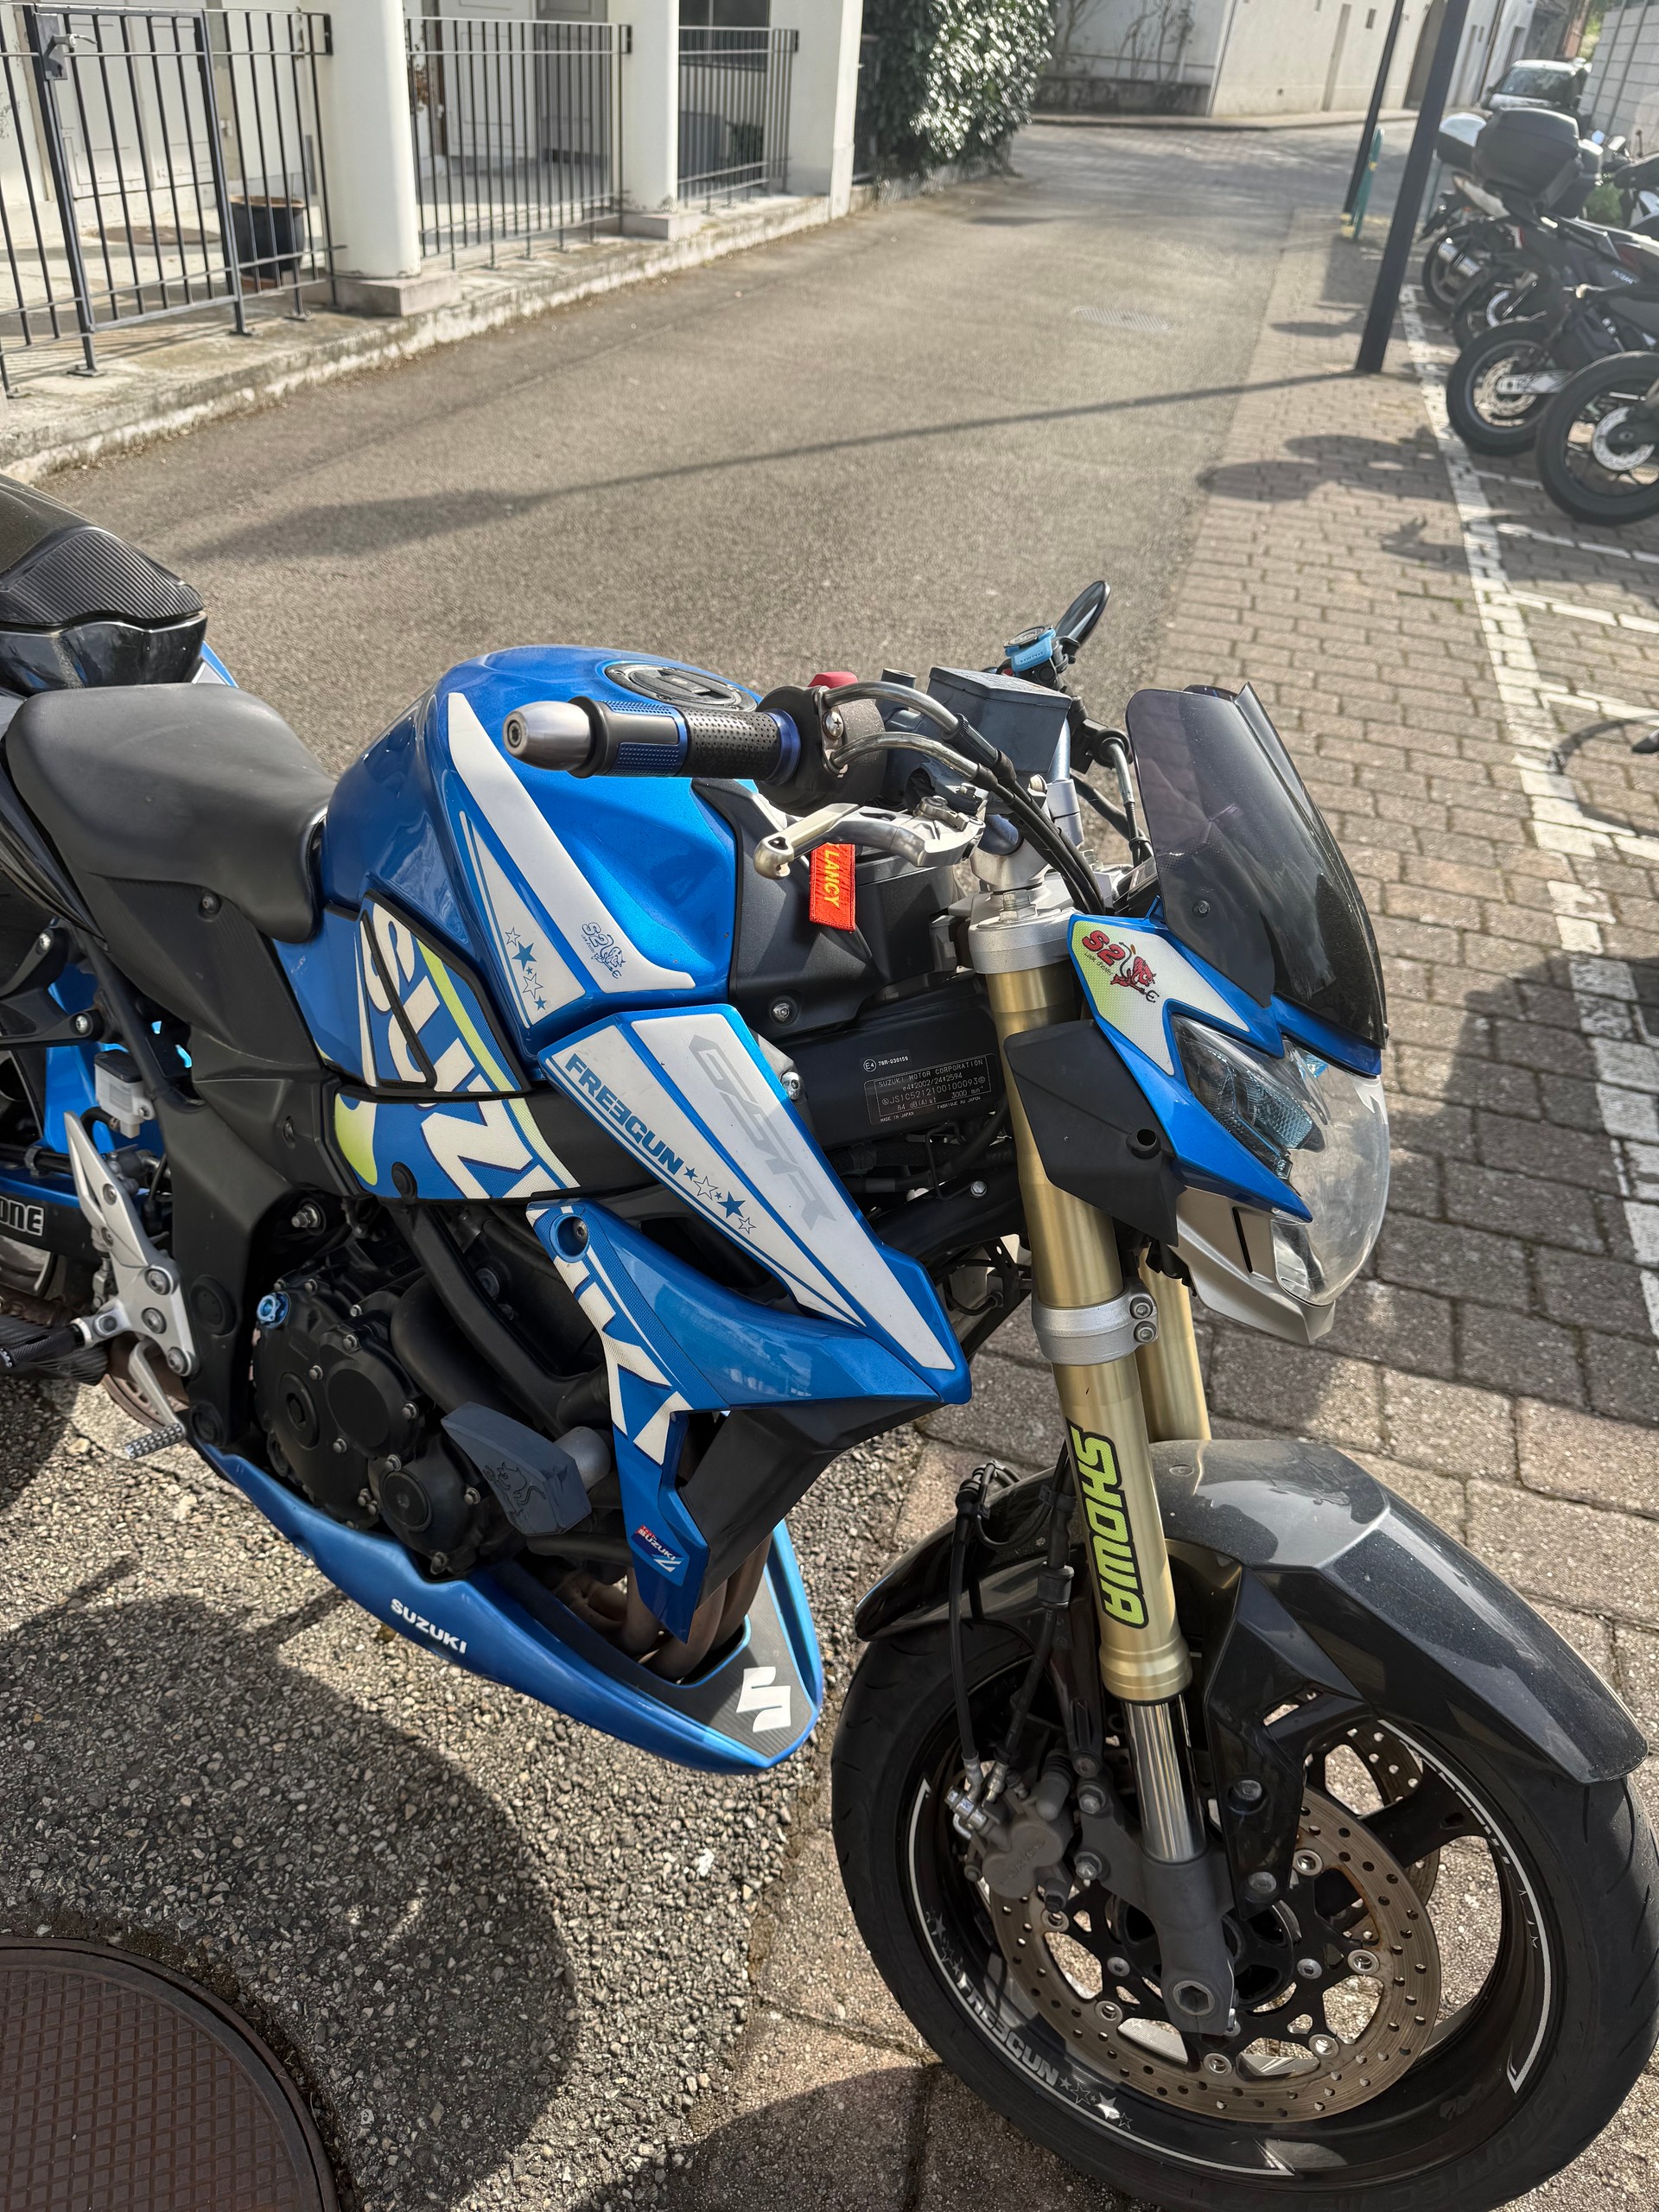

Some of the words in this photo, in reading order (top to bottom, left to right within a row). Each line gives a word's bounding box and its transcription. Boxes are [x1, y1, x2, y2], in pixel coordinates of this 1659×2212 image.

[823, 849, 840, 908] LANCY
[1082, 930, 1126, 967] S2
[879, 1077, 904, 1088] SUZUKI
[909, 1071, 931, 1081] MOTOR
[935, 1059, 983, 1075] CORPORATION
[638, 1529, 677, 1561] SUZUKI
[1069, 1422, 1147, 1627] SHOWA
[391, 1598, 467, 1655] SUZUKI
